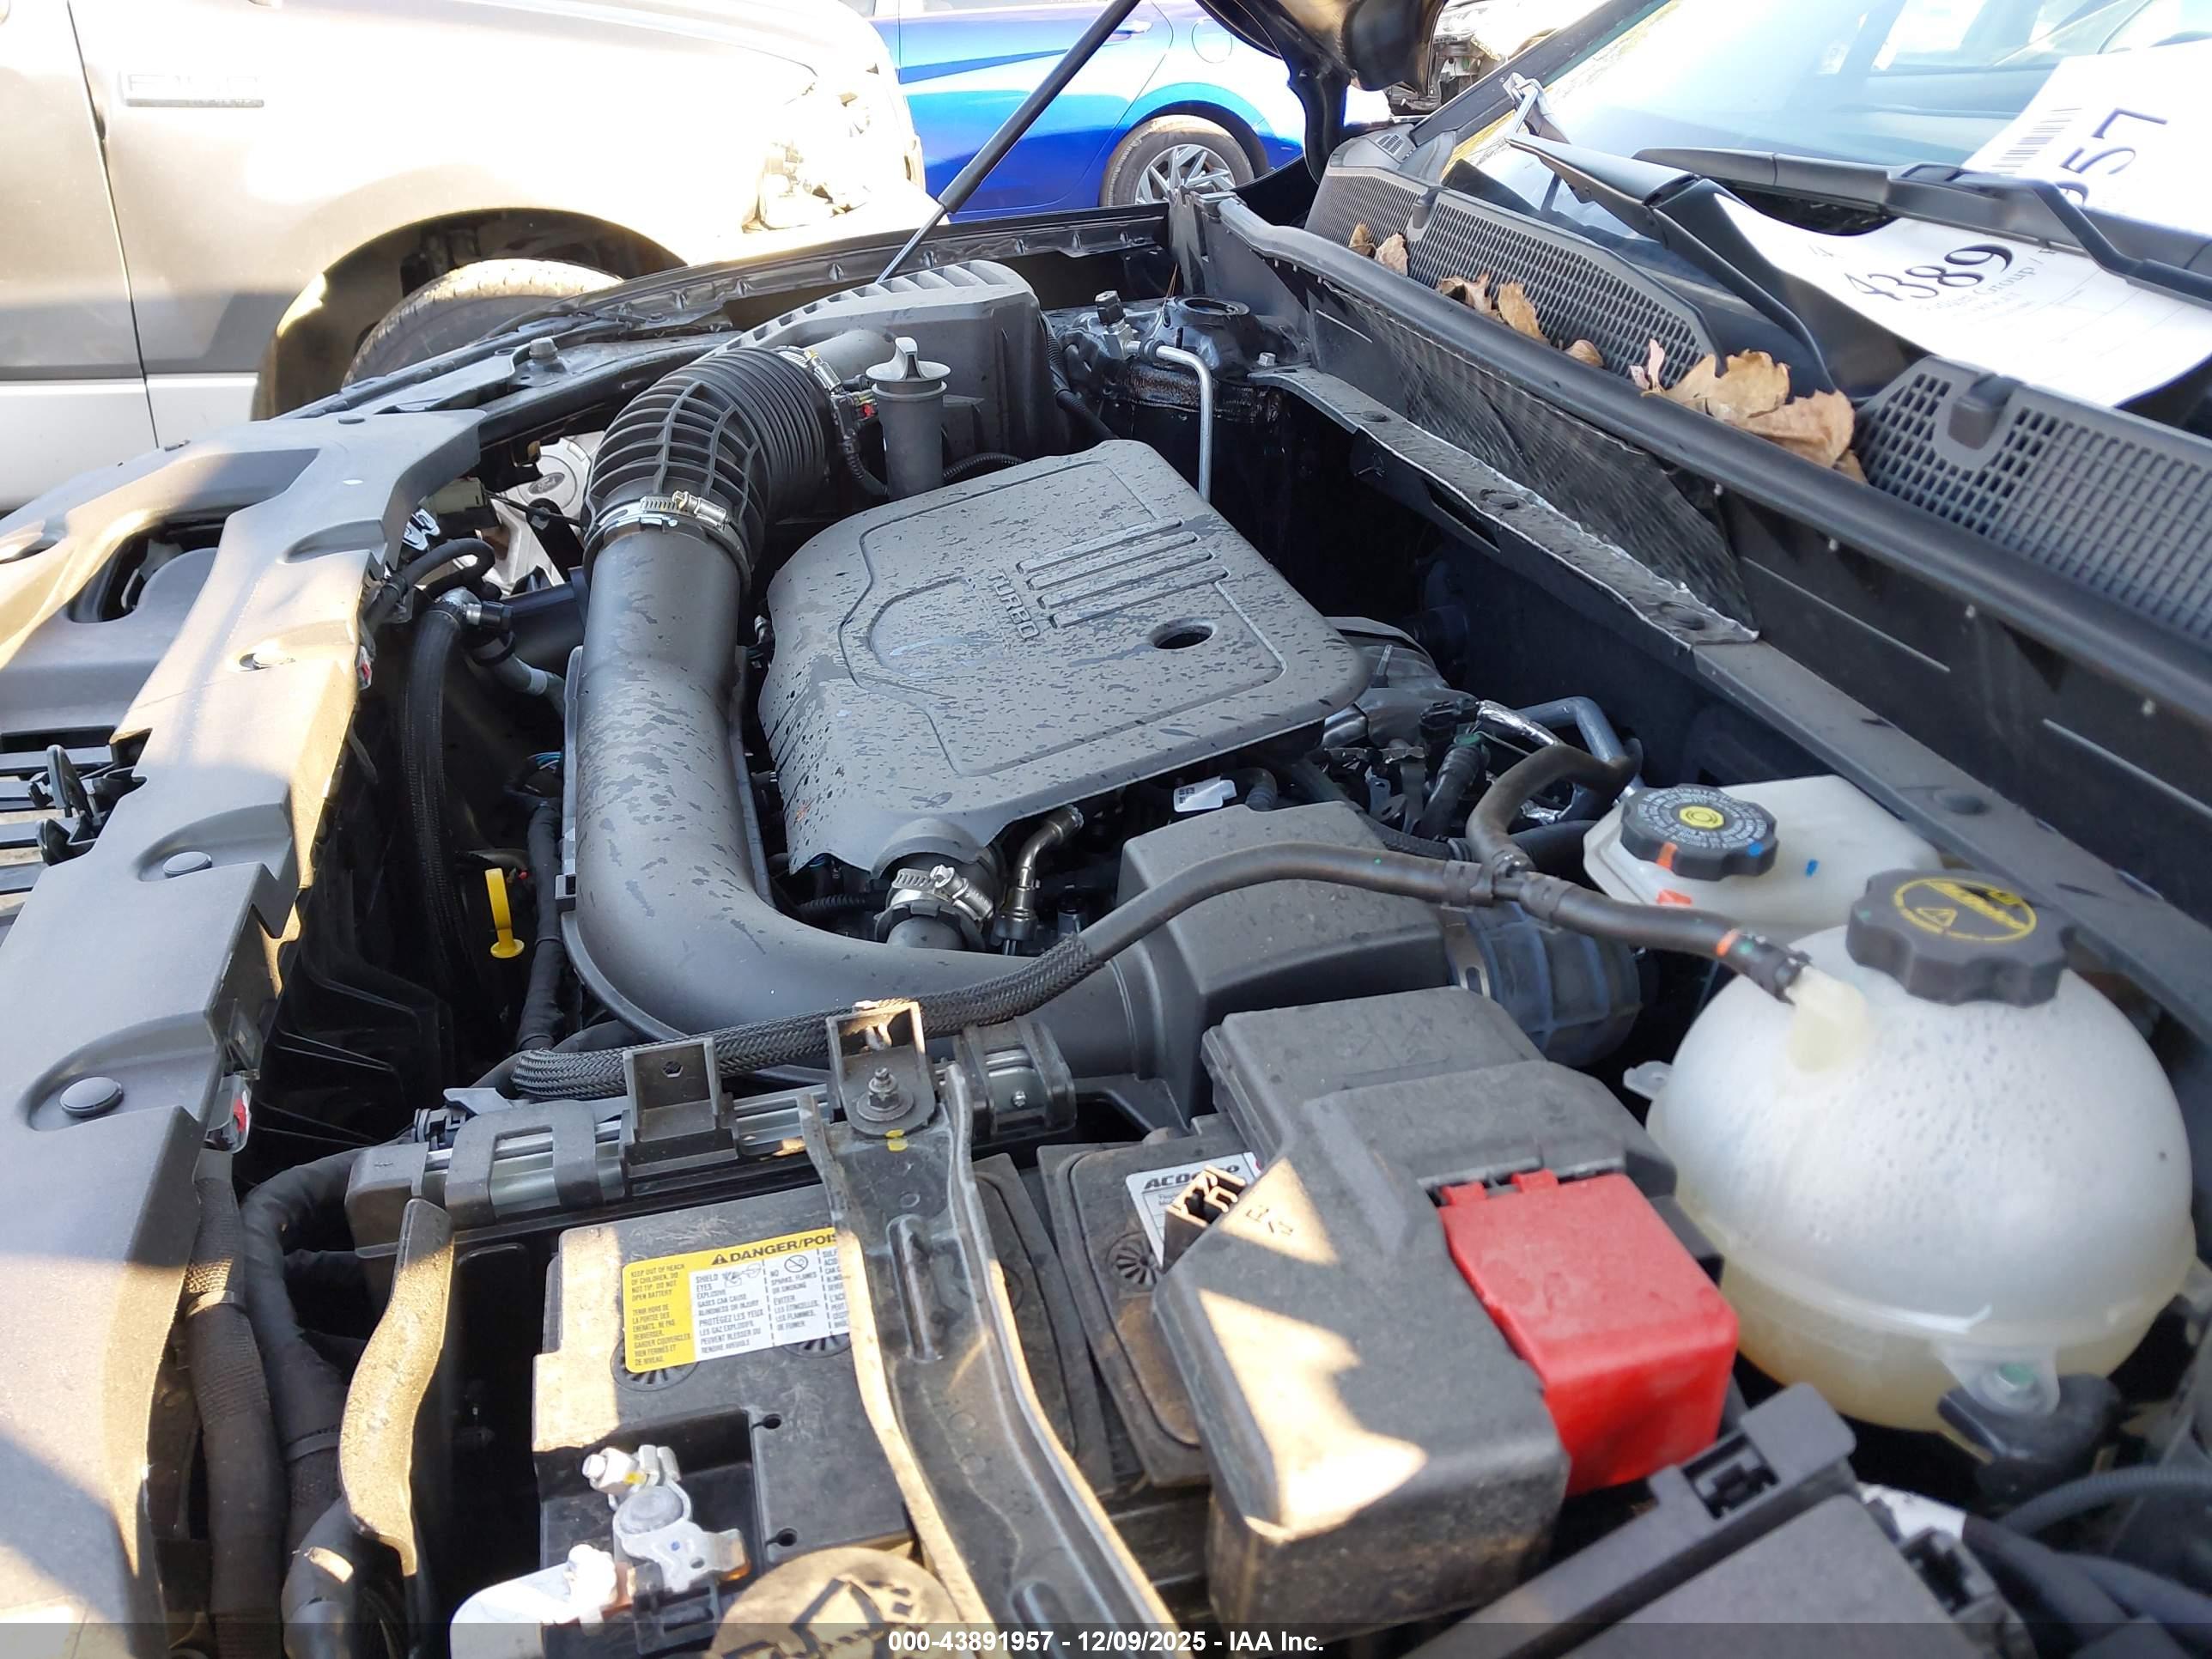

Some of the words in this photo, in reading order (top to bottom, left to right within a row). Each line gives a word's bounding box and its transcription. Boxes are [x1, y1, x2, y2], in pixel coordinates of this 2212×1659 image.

[988, 568, 1040, 641] TURBO
[696, 1273, 718, 1284] SHIELD
[696, 1284, 712, 1292] EYES
[697, 1299, 714, 1308] GASES
[730, 1293, 746, 1302] CAUSE
[734, 1312, 744, 1321] LES
[747, 1309, 763, 1317] YEUX
[700, 1328, 709, 1336] LES
